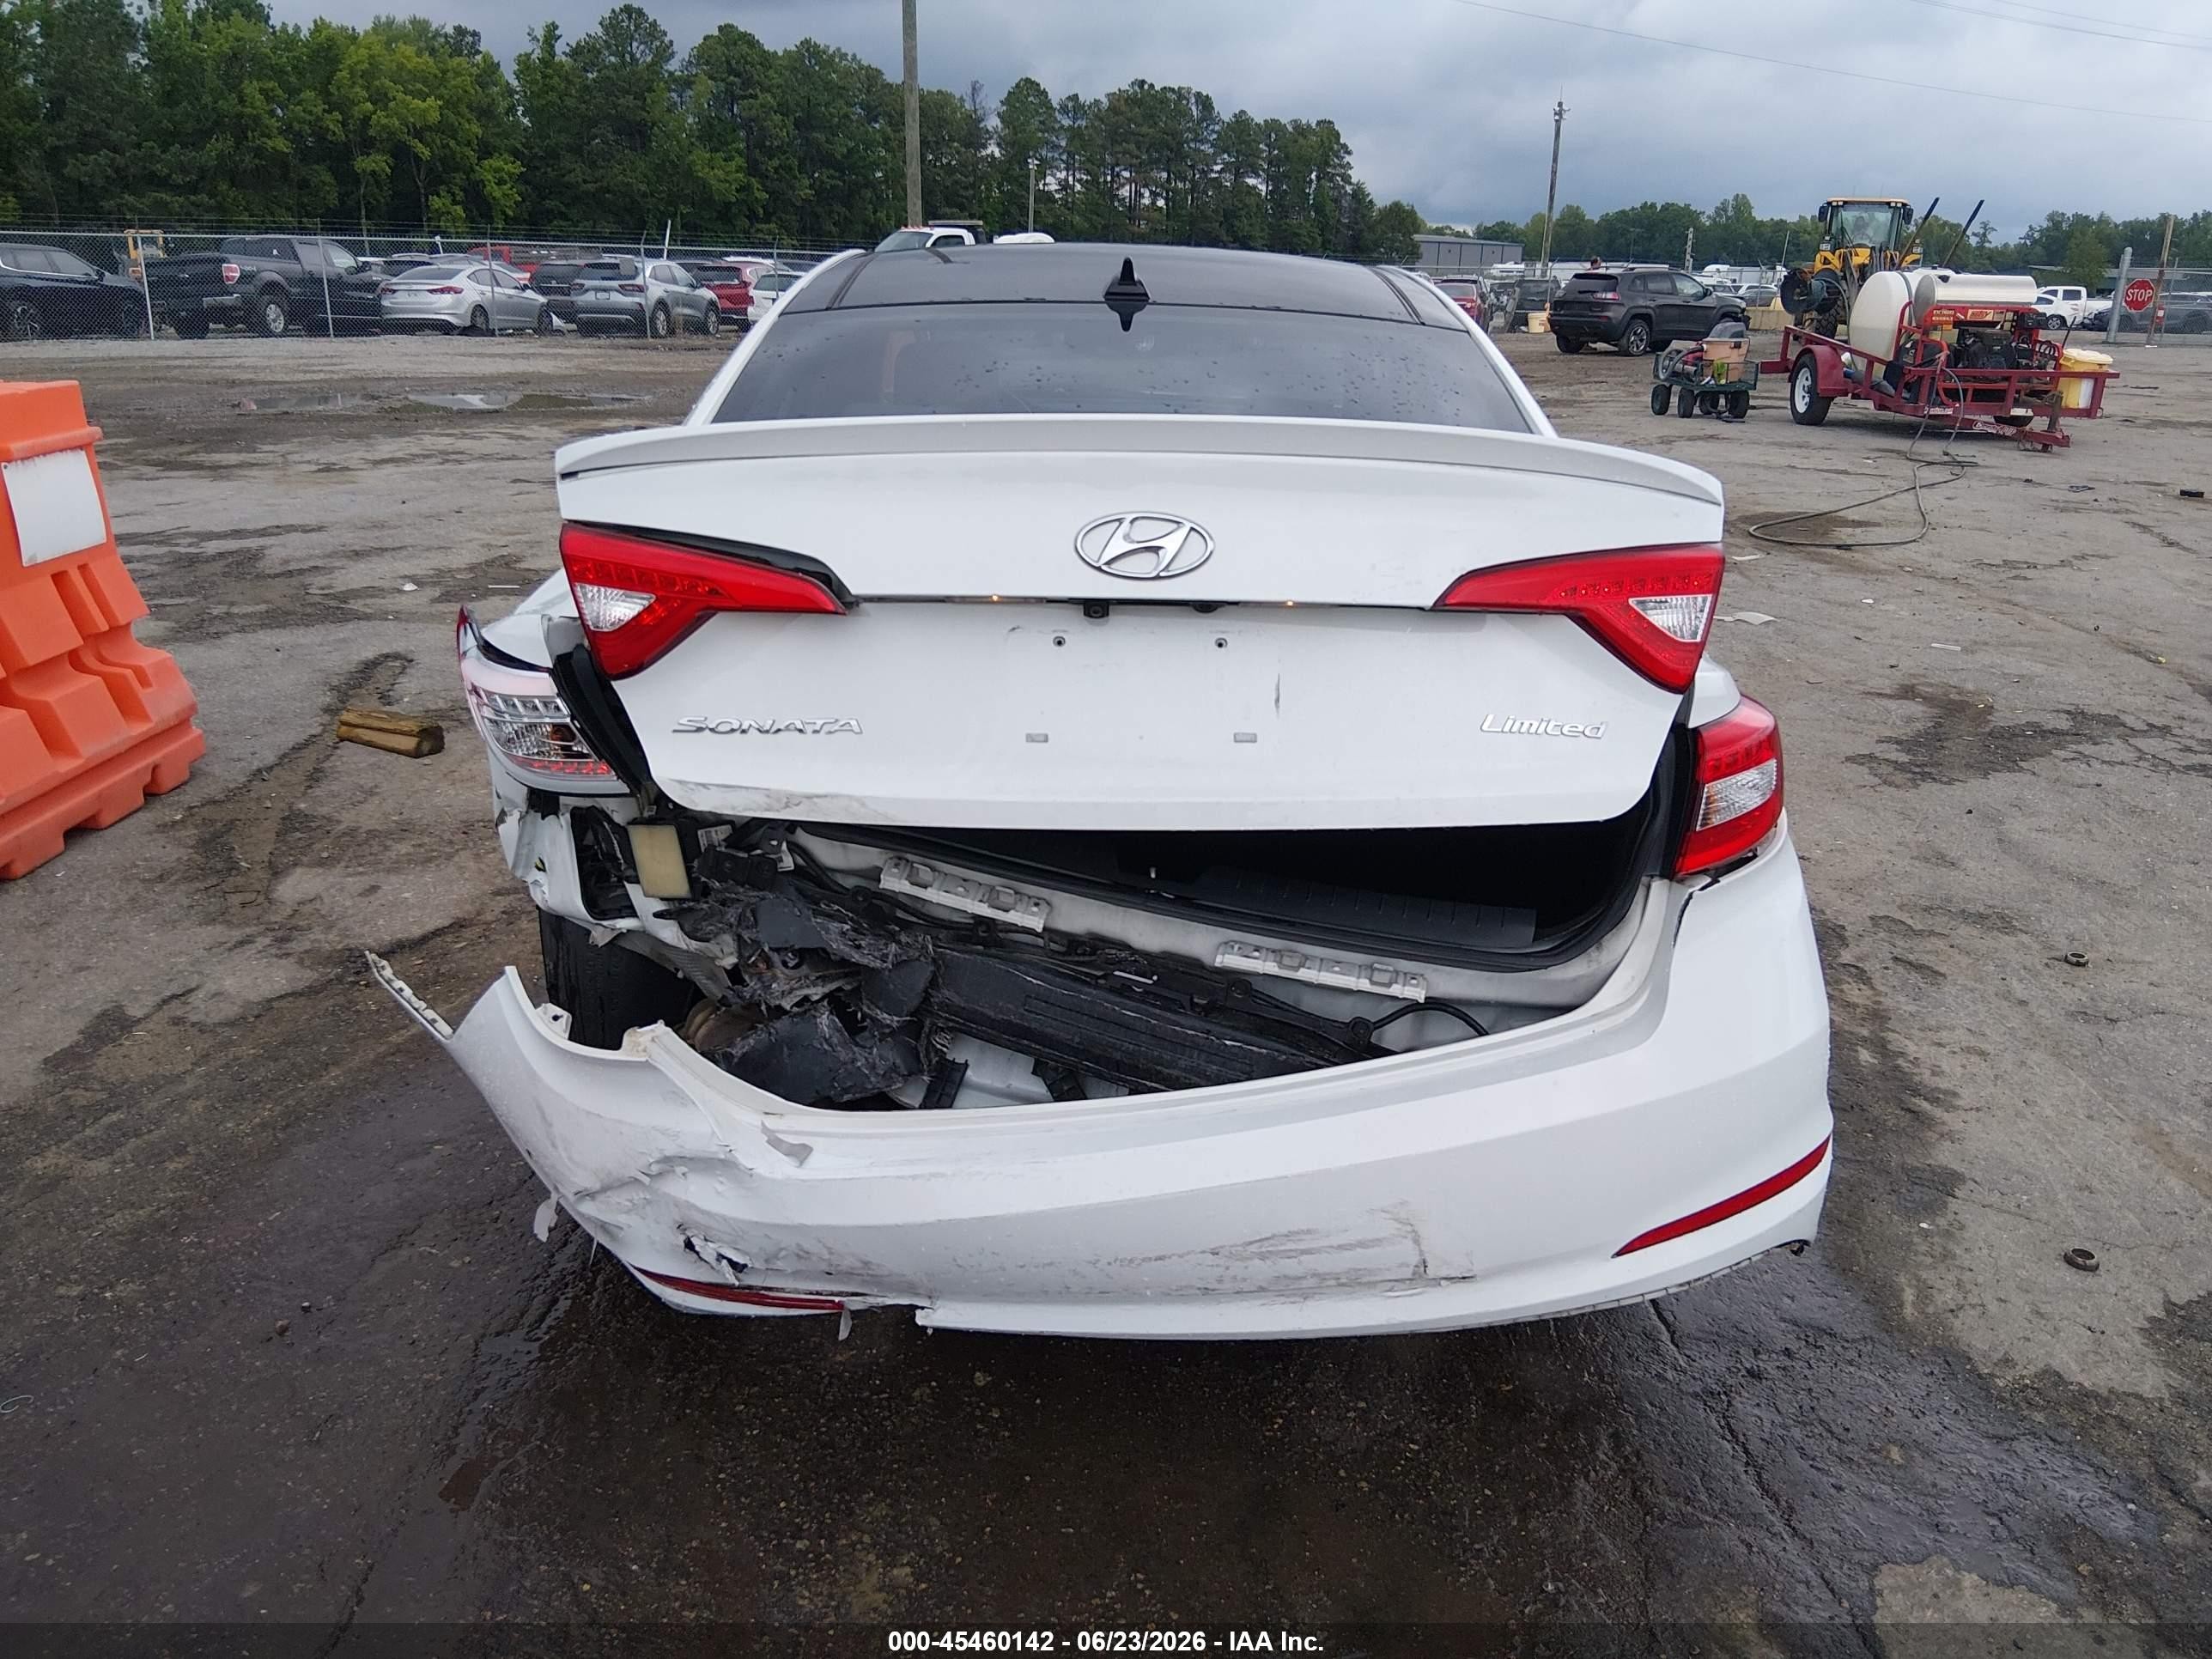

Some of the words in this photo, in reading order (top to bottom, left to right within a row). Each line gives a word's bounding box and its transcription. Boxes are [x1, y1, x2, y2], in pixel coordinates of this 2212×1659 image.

[2125, 289, 2153, 301] STOP
[672, 716, 863, 735] SONATA
[1480, 714, 1607, 739] Limited
